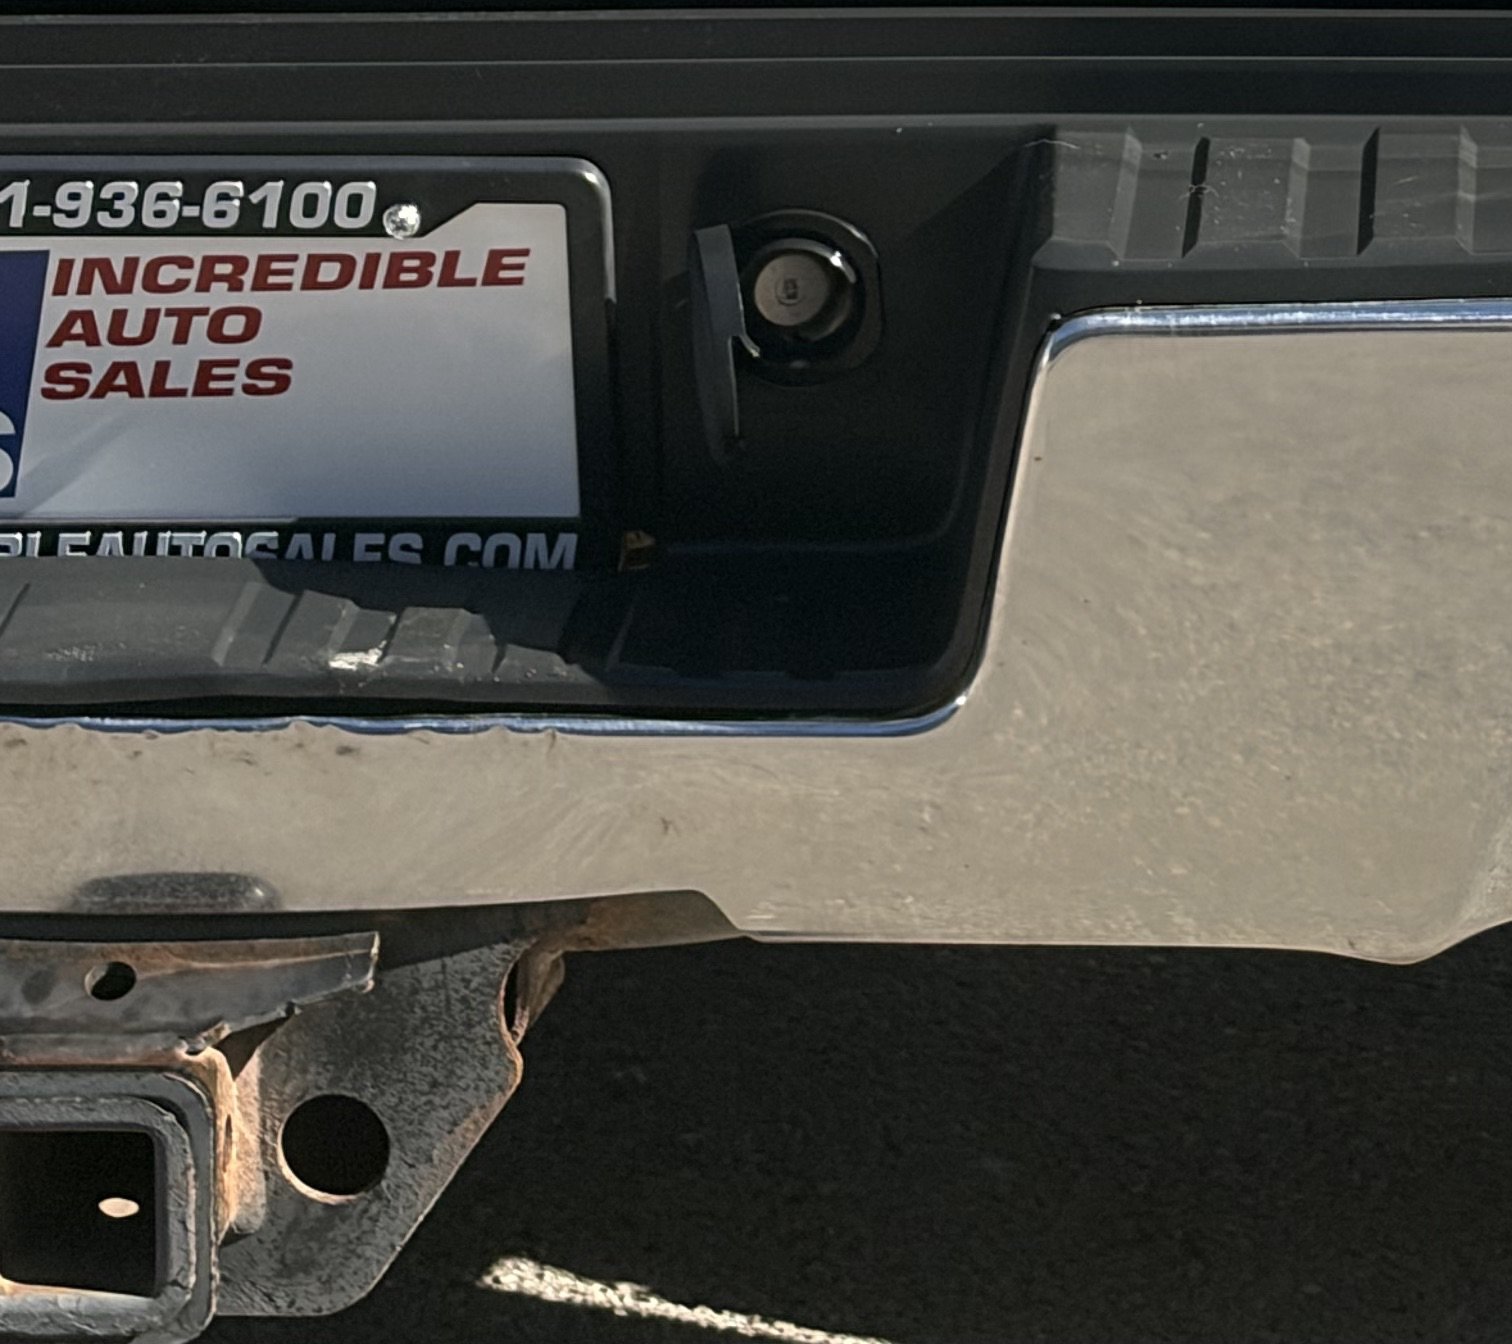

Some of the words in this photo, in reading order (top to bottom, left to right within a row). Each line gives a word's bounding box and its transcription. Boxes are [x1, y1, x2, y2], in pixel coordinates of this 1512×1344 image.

[0, 180, 377, 229] 1-936-6100
[52, 248, 530, 296] INCREDIBLE
[46, 306, 262, 348] AUTO
[40, 358, 294, 400] SALES
